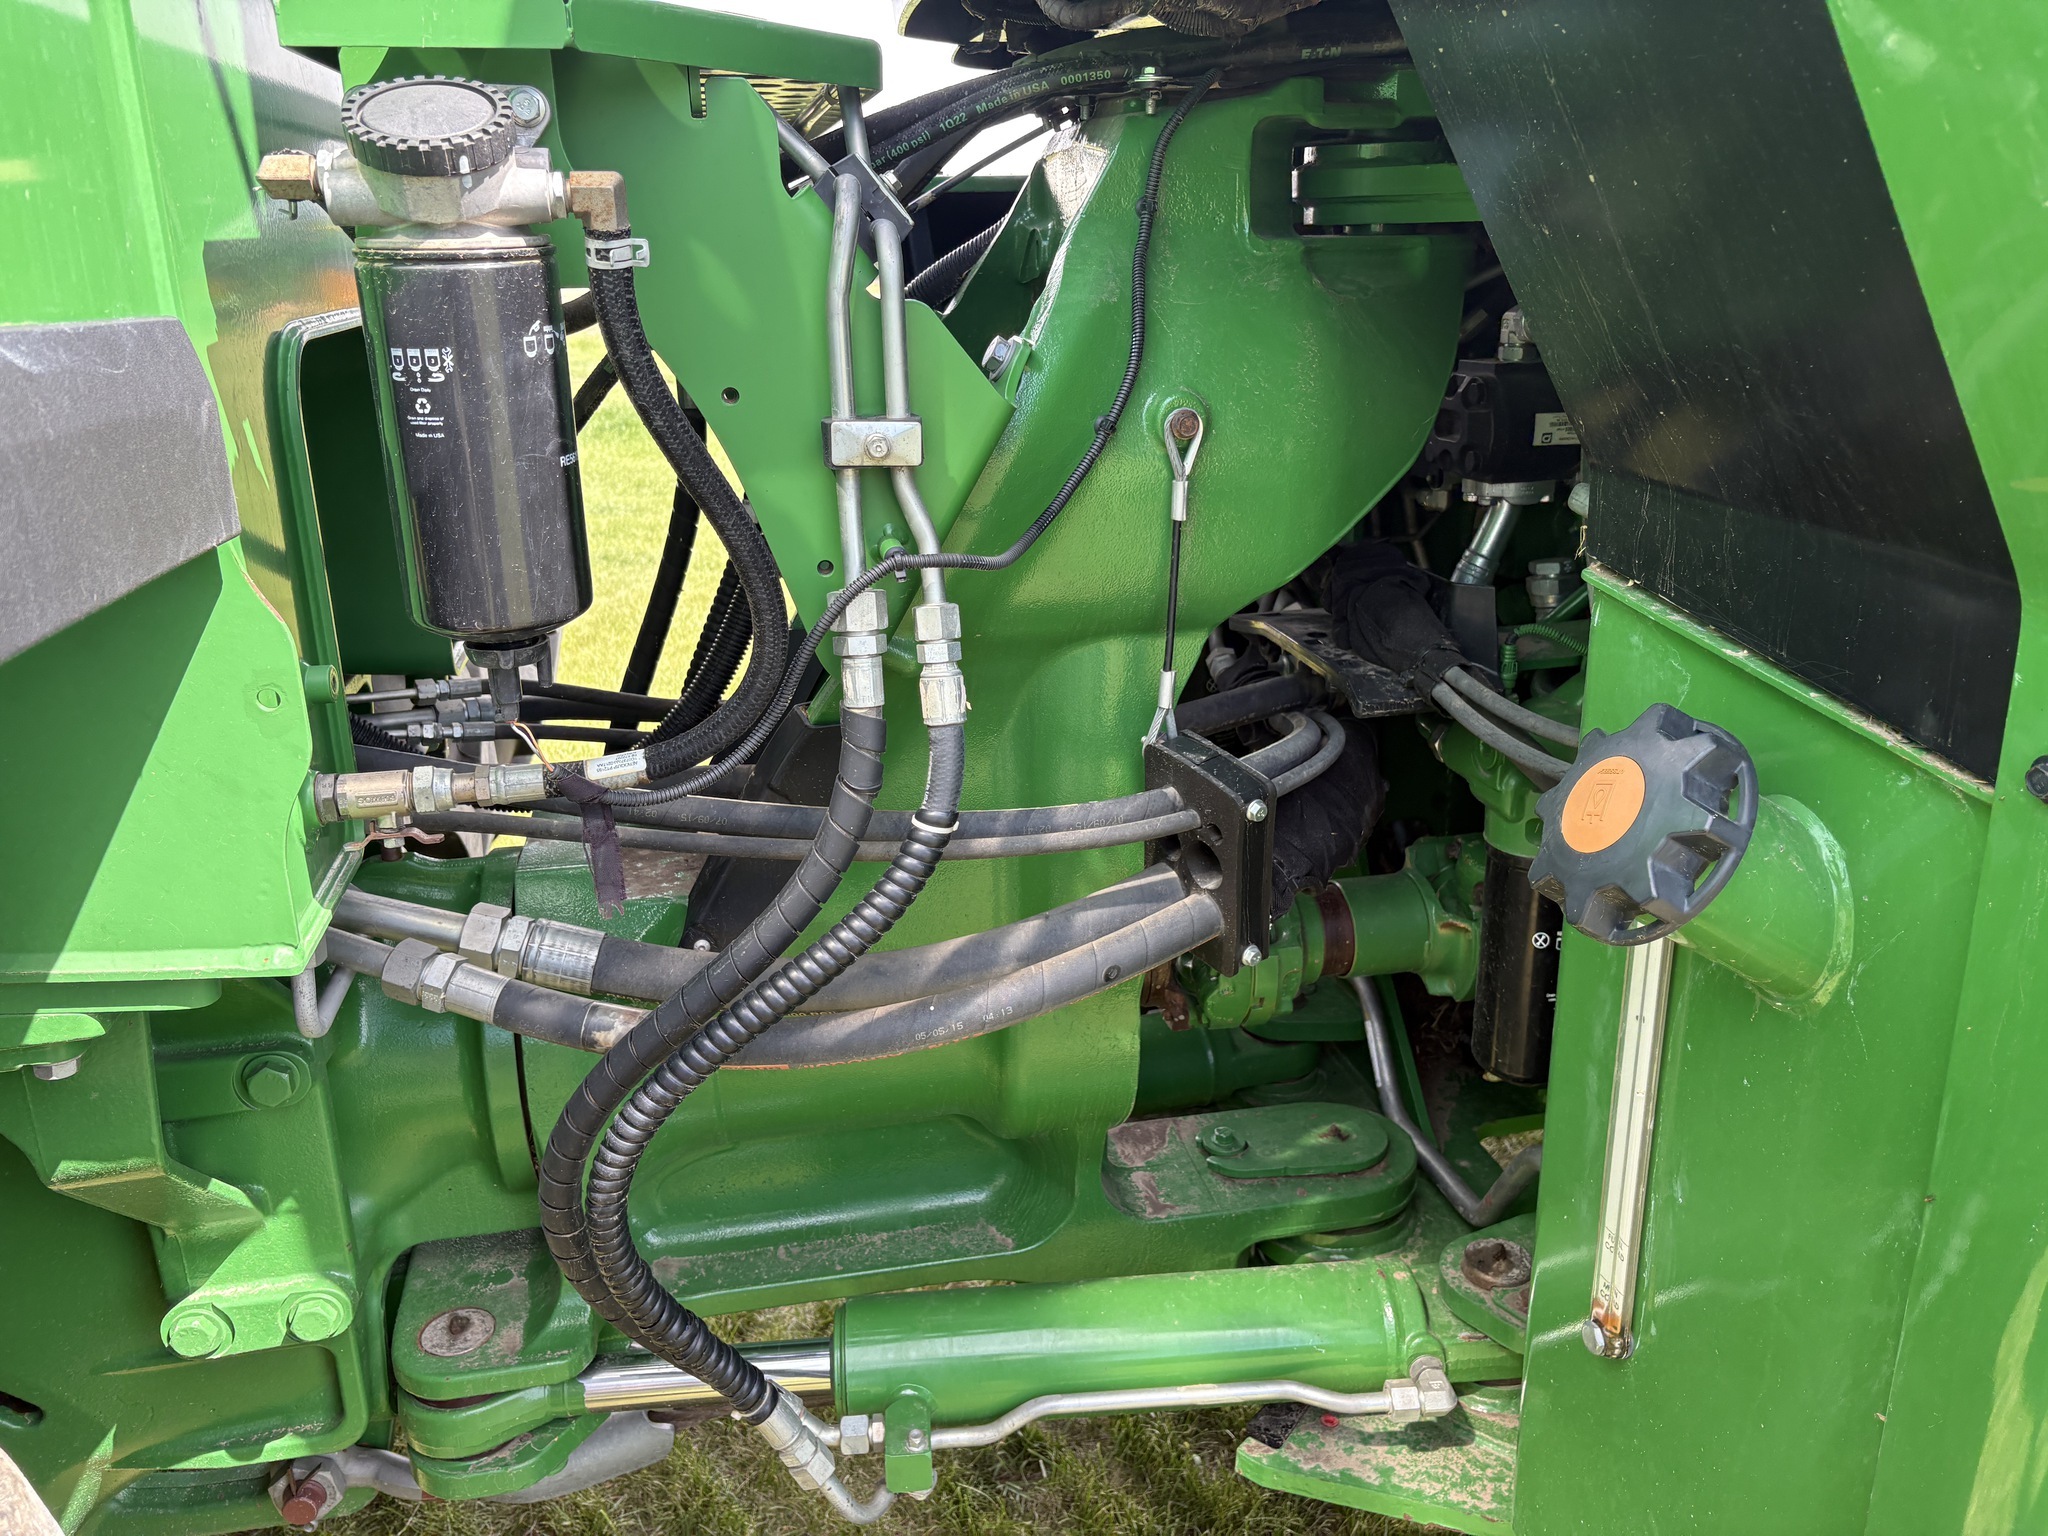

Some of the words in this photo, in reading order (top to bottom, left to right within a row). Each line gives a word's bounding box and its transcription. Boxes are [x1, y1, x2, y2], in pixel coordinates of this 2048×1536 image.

[887, 142, 910, 160] (400
[910, 130, 931, 150] psi)
[939, 111, 968, 132] 1Q22
[975, 96, 1008, 114] Made
[1009, 90, 1022, 101] in
[1023, 81, 1050, 97] USA
[1060, 69, 1112, 86] 0001350
[915, 1021, 964, 1041] 05/05/15
[982, 1006, 1014, 1022] 04:13
